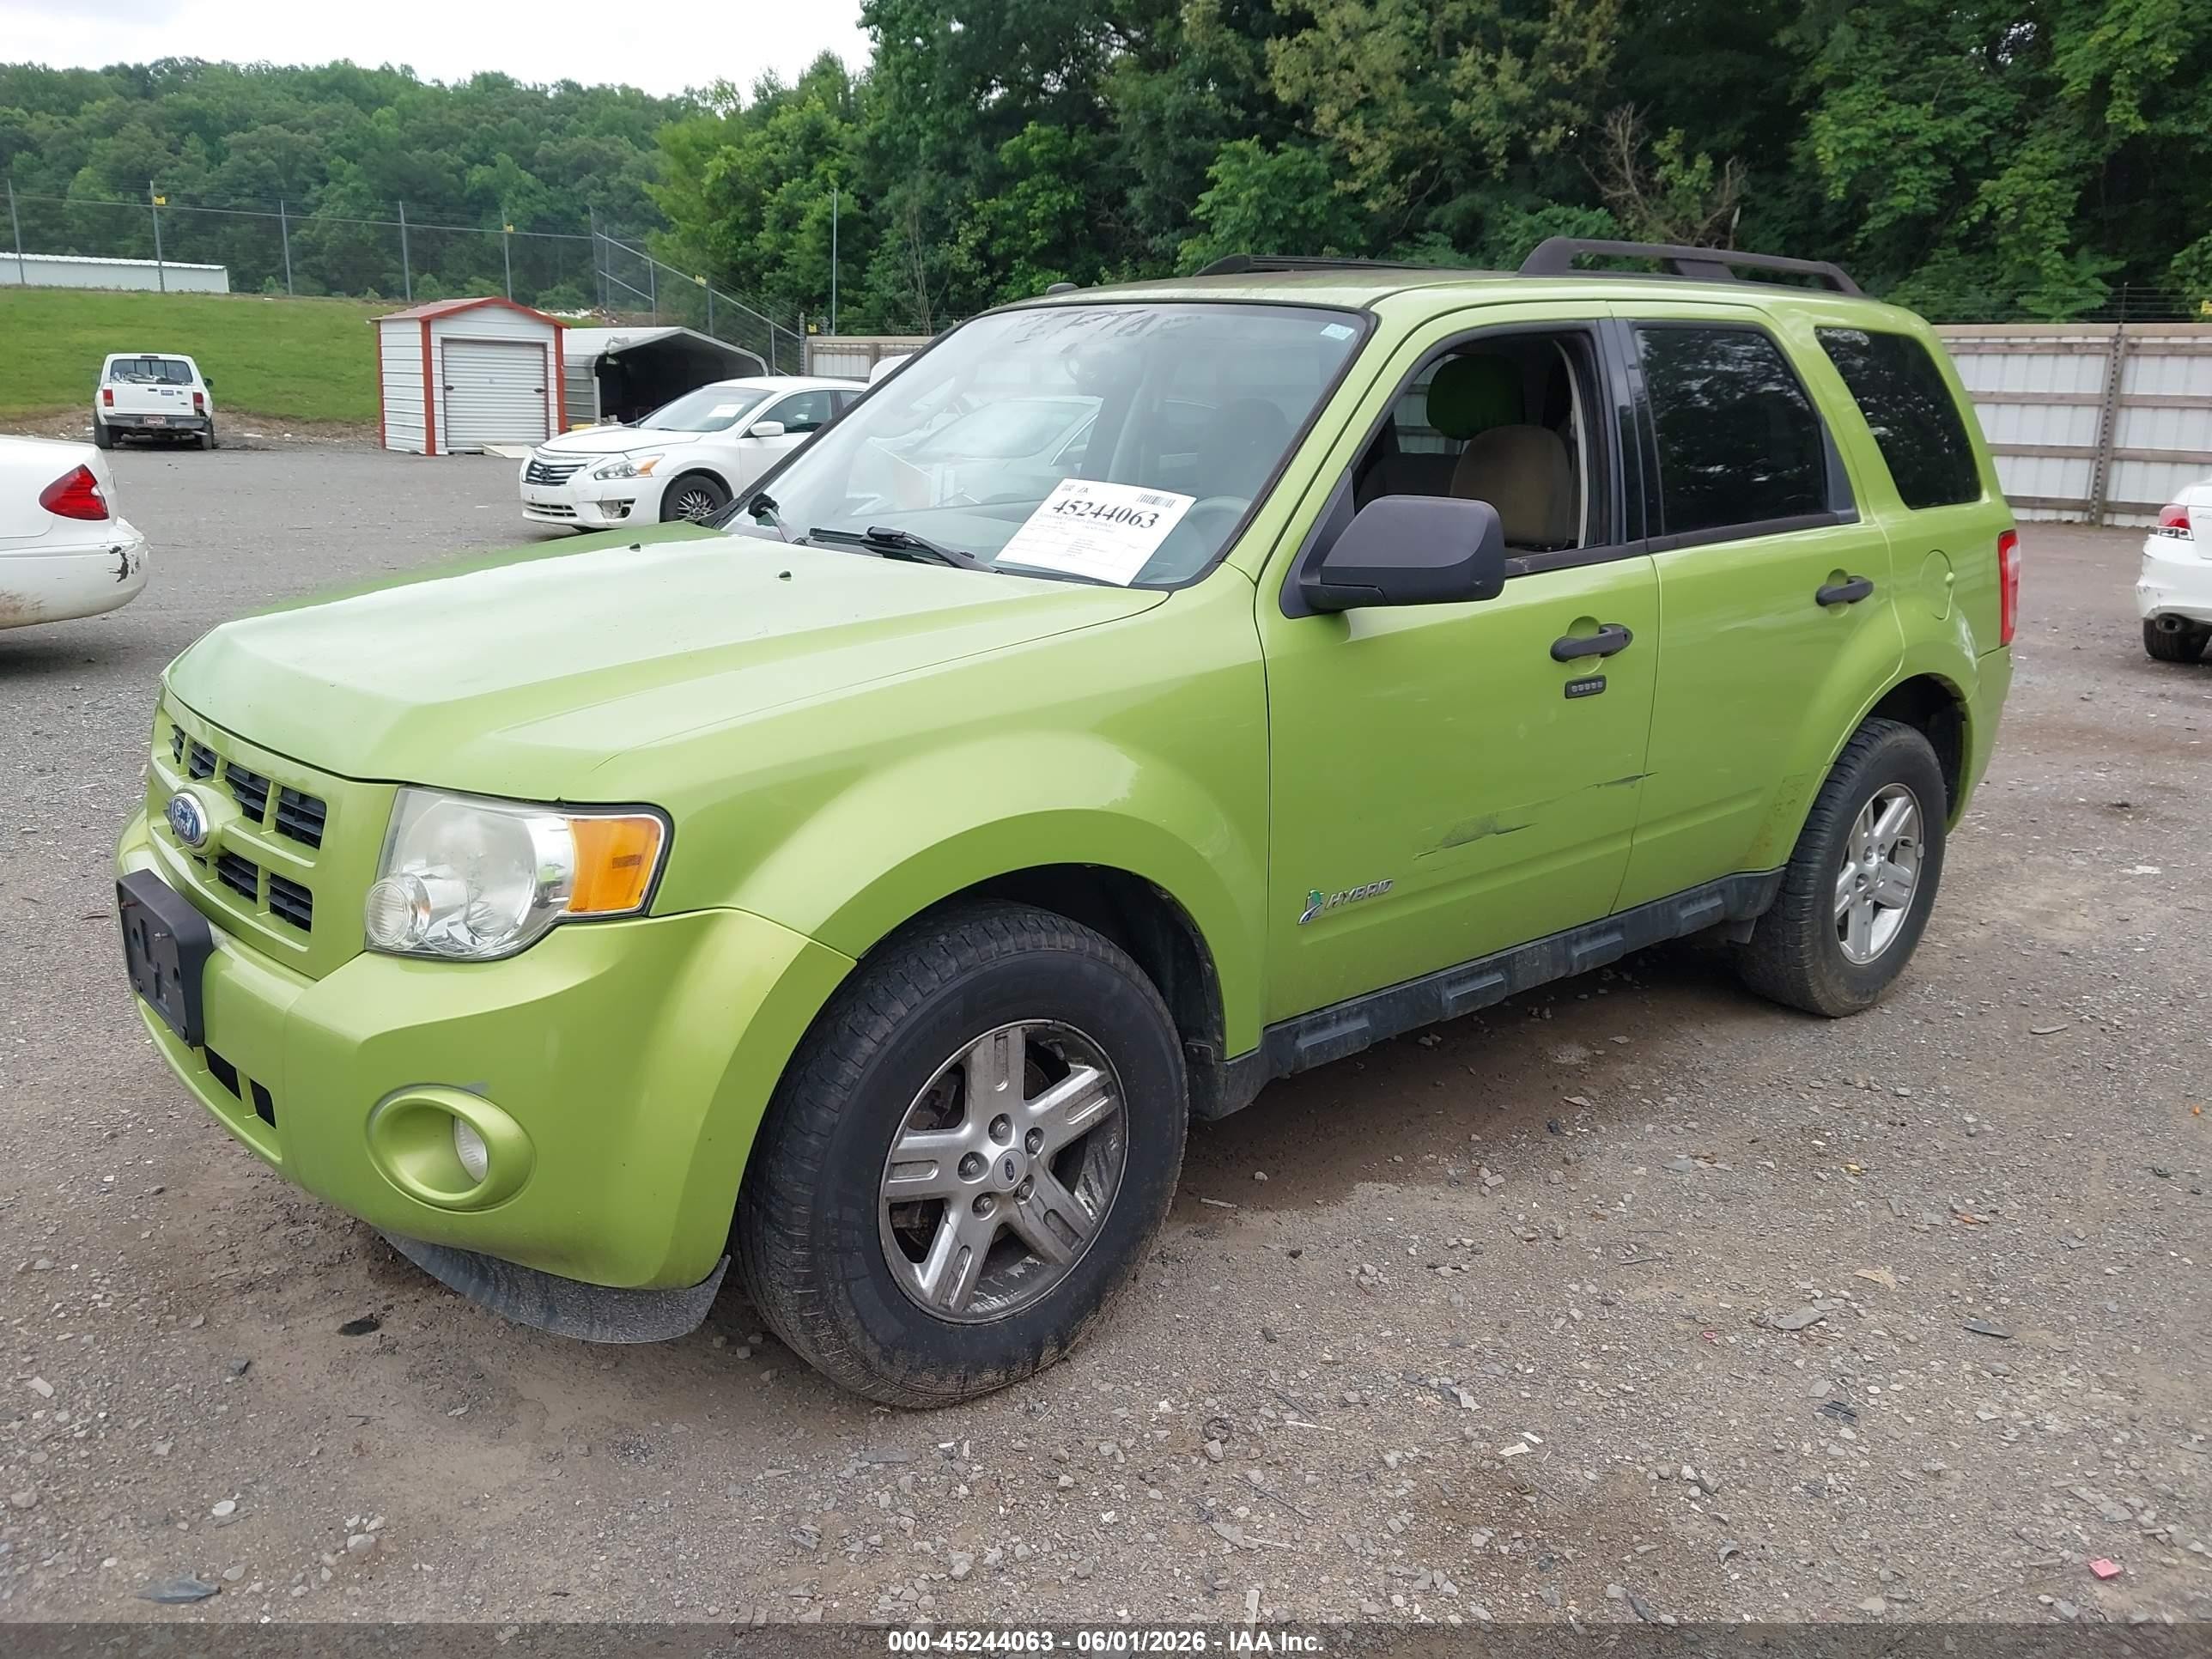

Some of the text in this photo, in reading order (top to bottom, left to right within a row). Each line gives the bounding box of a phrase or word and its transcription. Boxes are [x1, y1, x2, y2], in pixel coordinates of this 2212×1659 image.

[1052, 498, 1160, 529] 45244063
[172, 799, 198, 838] Ford
[1324, 878, 1394, 910] HYBRID
